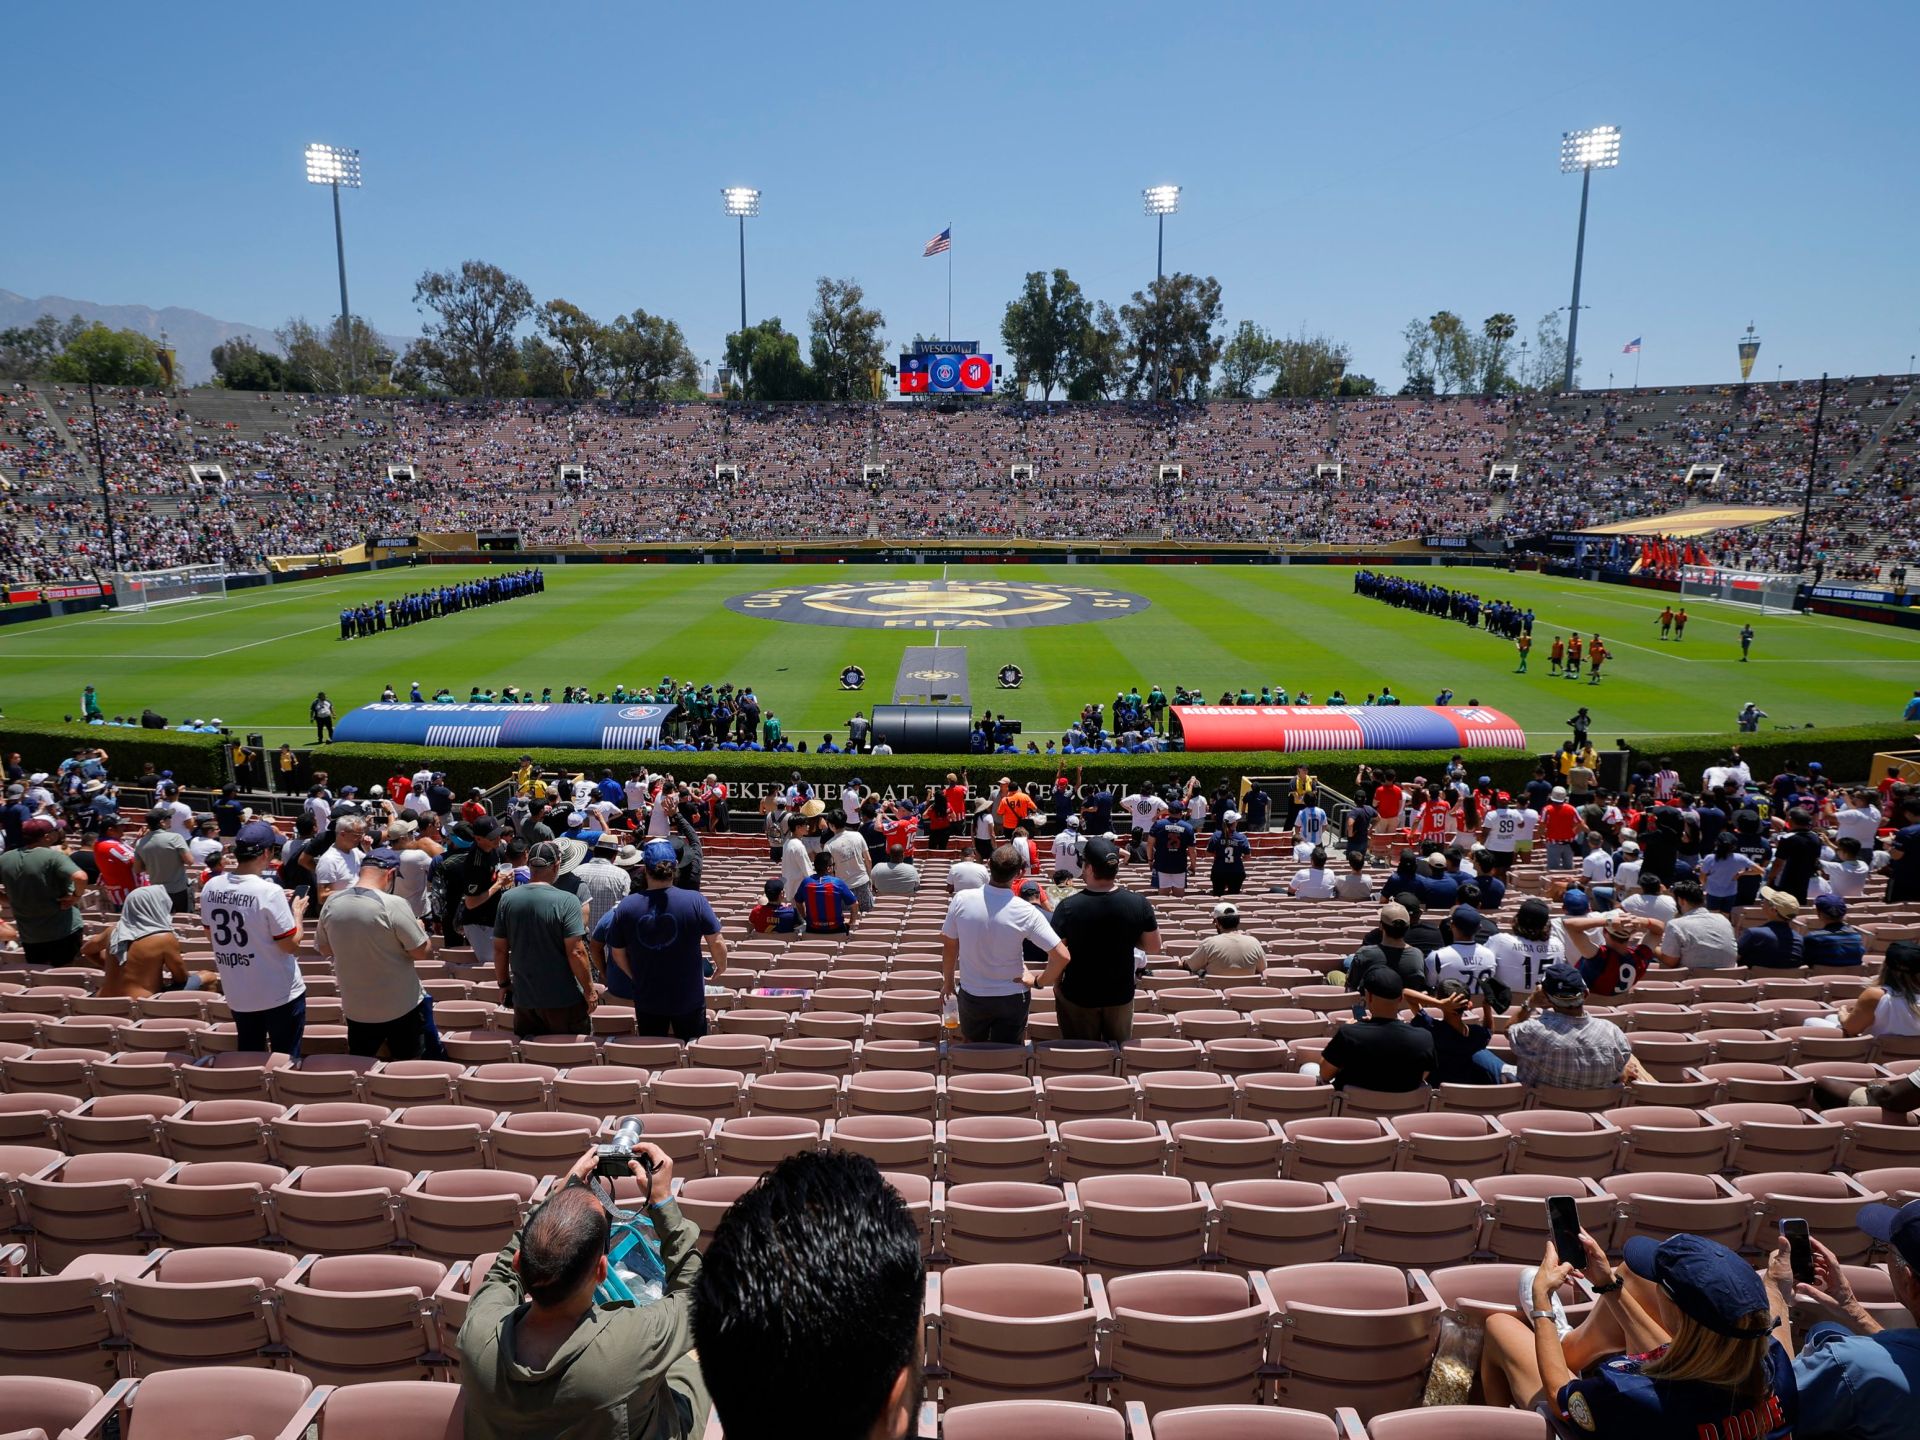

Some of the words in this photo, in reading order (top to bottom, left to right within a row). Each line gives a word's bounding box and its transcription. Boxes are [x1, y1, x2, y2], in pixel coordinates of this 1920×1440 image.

[921, 344, 960, 353] WESCOM
[1427, 538, 1439, 546] LOS
[1440, 538, 1467, 546] ANGELES
[743, 589, 808, 608] CLUB
[1812, 588, 1832, 597] PARIS
[1833, 589, 1885, 601] SAINT-GERMAIN
[362, 703, 415, 711] Paris
[416, 703, 551, 712] Saint-Germain
[1262, 707, 1288, 715] de
[1291, 707, 1365, 716] Madrid
[882, 784, 914, 800] AT
[1308, 818, 1320, 833] 10
[1499, 820, 1514, 833] 89
[1224, 846, 1235, 864] 3
[1740, 846, 1766, 854] CHECO
[1604, 860, 1612, 879] 8
[211, 908, 249, 948] 33
[1512, 943, 1534, 953] ARDA
[1463, 956, 1483, 967] RUIZ
[1614, 963, 1636, 993] 9
